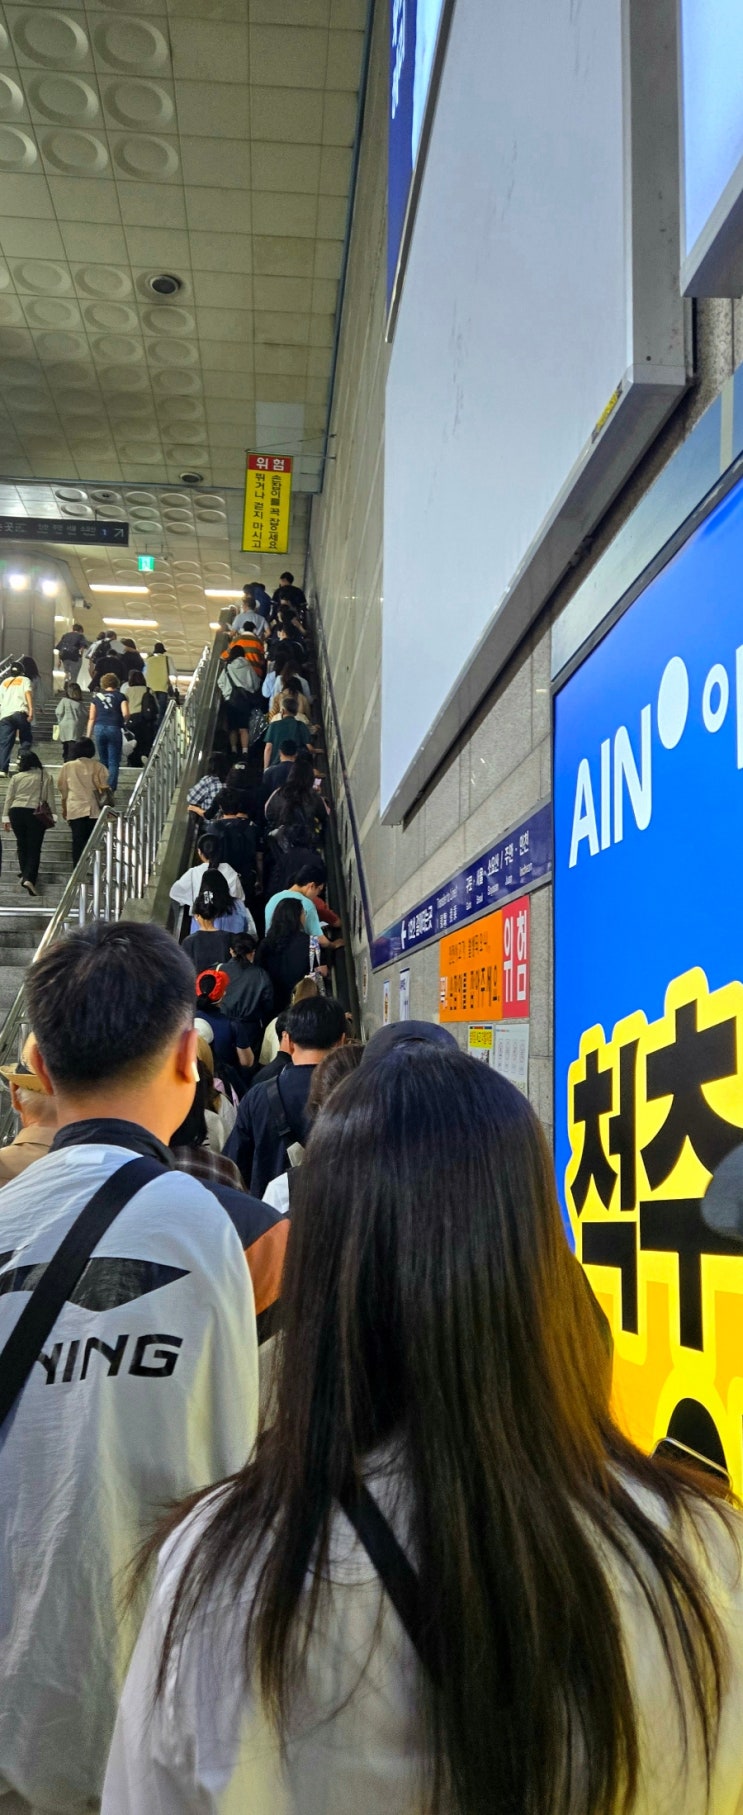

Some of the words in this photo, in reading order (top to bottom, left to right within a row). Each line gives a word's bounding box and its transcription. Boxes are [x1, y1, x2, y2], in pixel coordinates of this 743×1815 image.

[256, 457, 285, 471] 위험
[271, 475, 281, 506] 손잡이를
[252, 522, 264, 548] 마시고
[569, 704, 652, 869] AIN
[519, 830, 529, 856] 인천
[503, 910, 527, 1003] 위험
